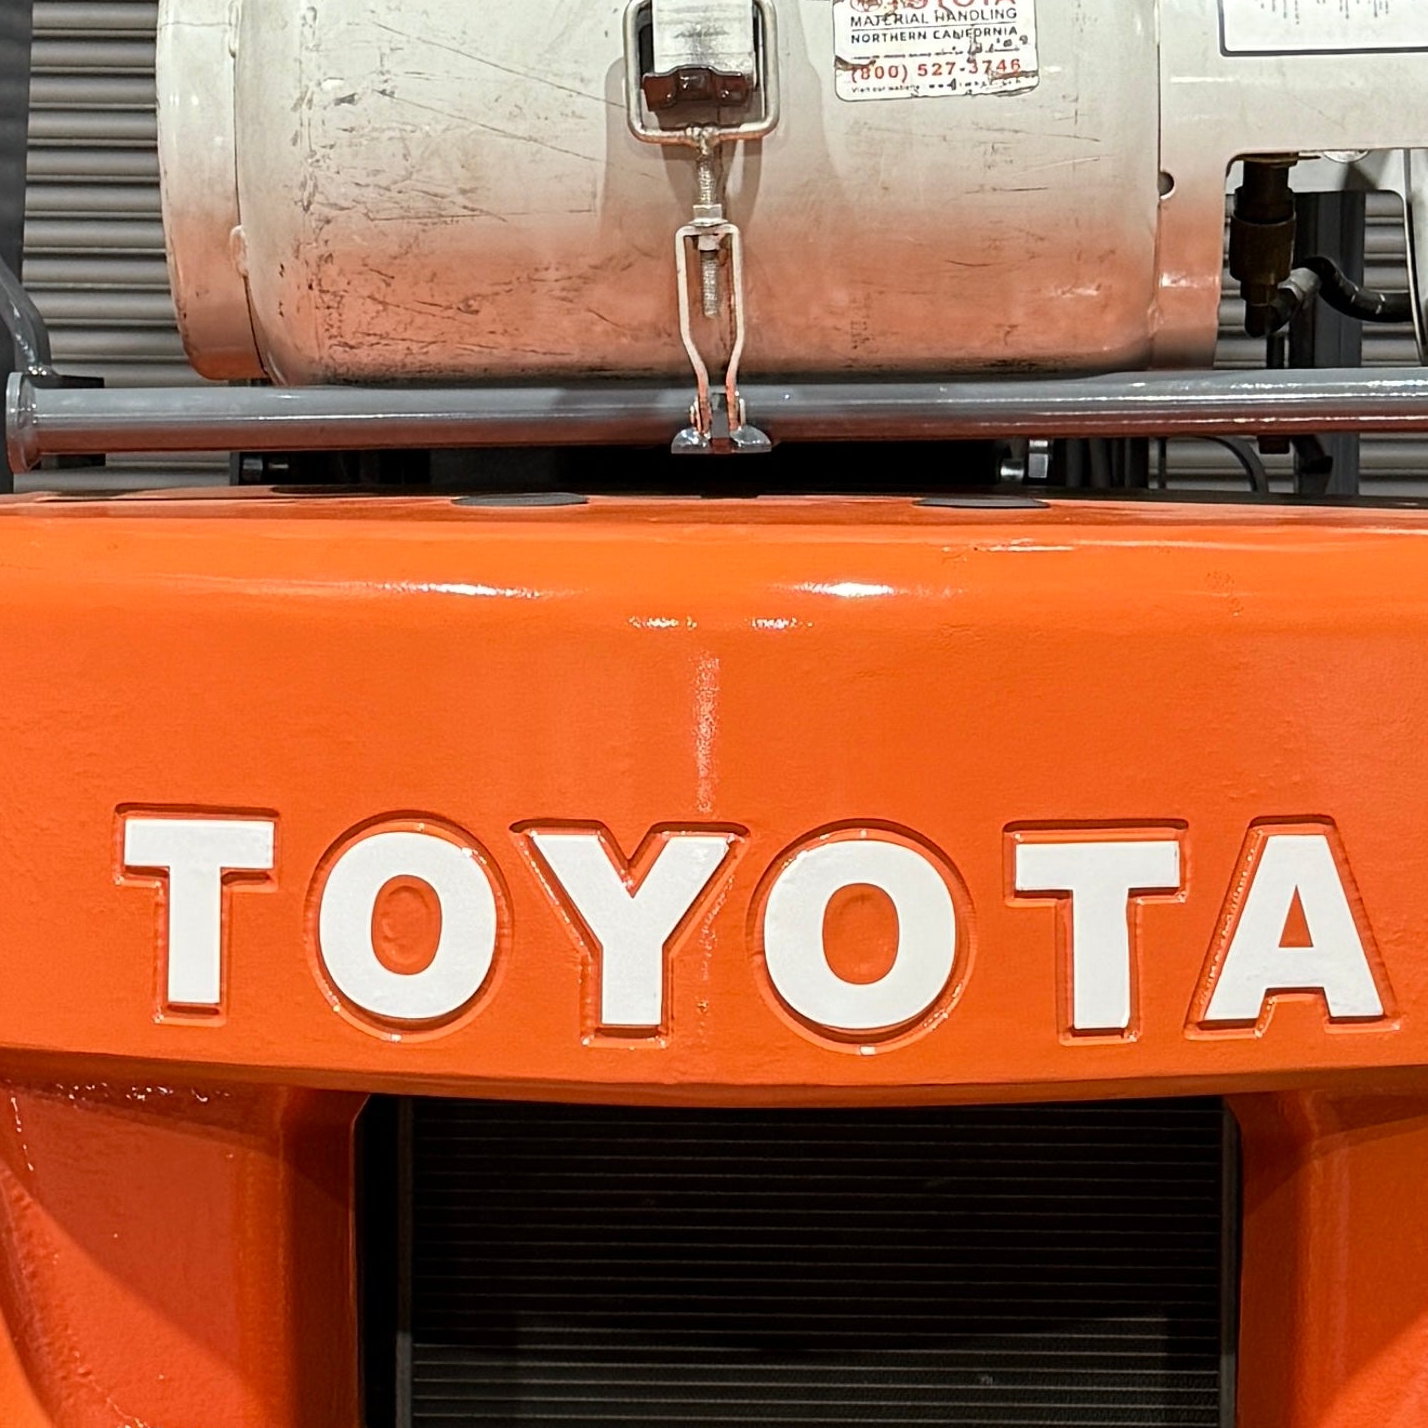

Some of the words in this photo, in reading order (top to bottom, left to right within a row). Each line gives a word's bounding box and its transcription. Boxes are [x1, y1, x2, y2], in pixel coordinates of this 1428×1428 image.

[850, 12, 929, 28] MATERIAL
[934, 7, 1018, 23] HANDLING
[850, 32, 927, 44] NORTHERN
[933, 26, 1018, 40] CALIFORNIA
[850, 64, 908, 84] (800)
[917, 58, 1022, 77] 527-3746
[123, 817, 1383, 1031] TOYOTA
